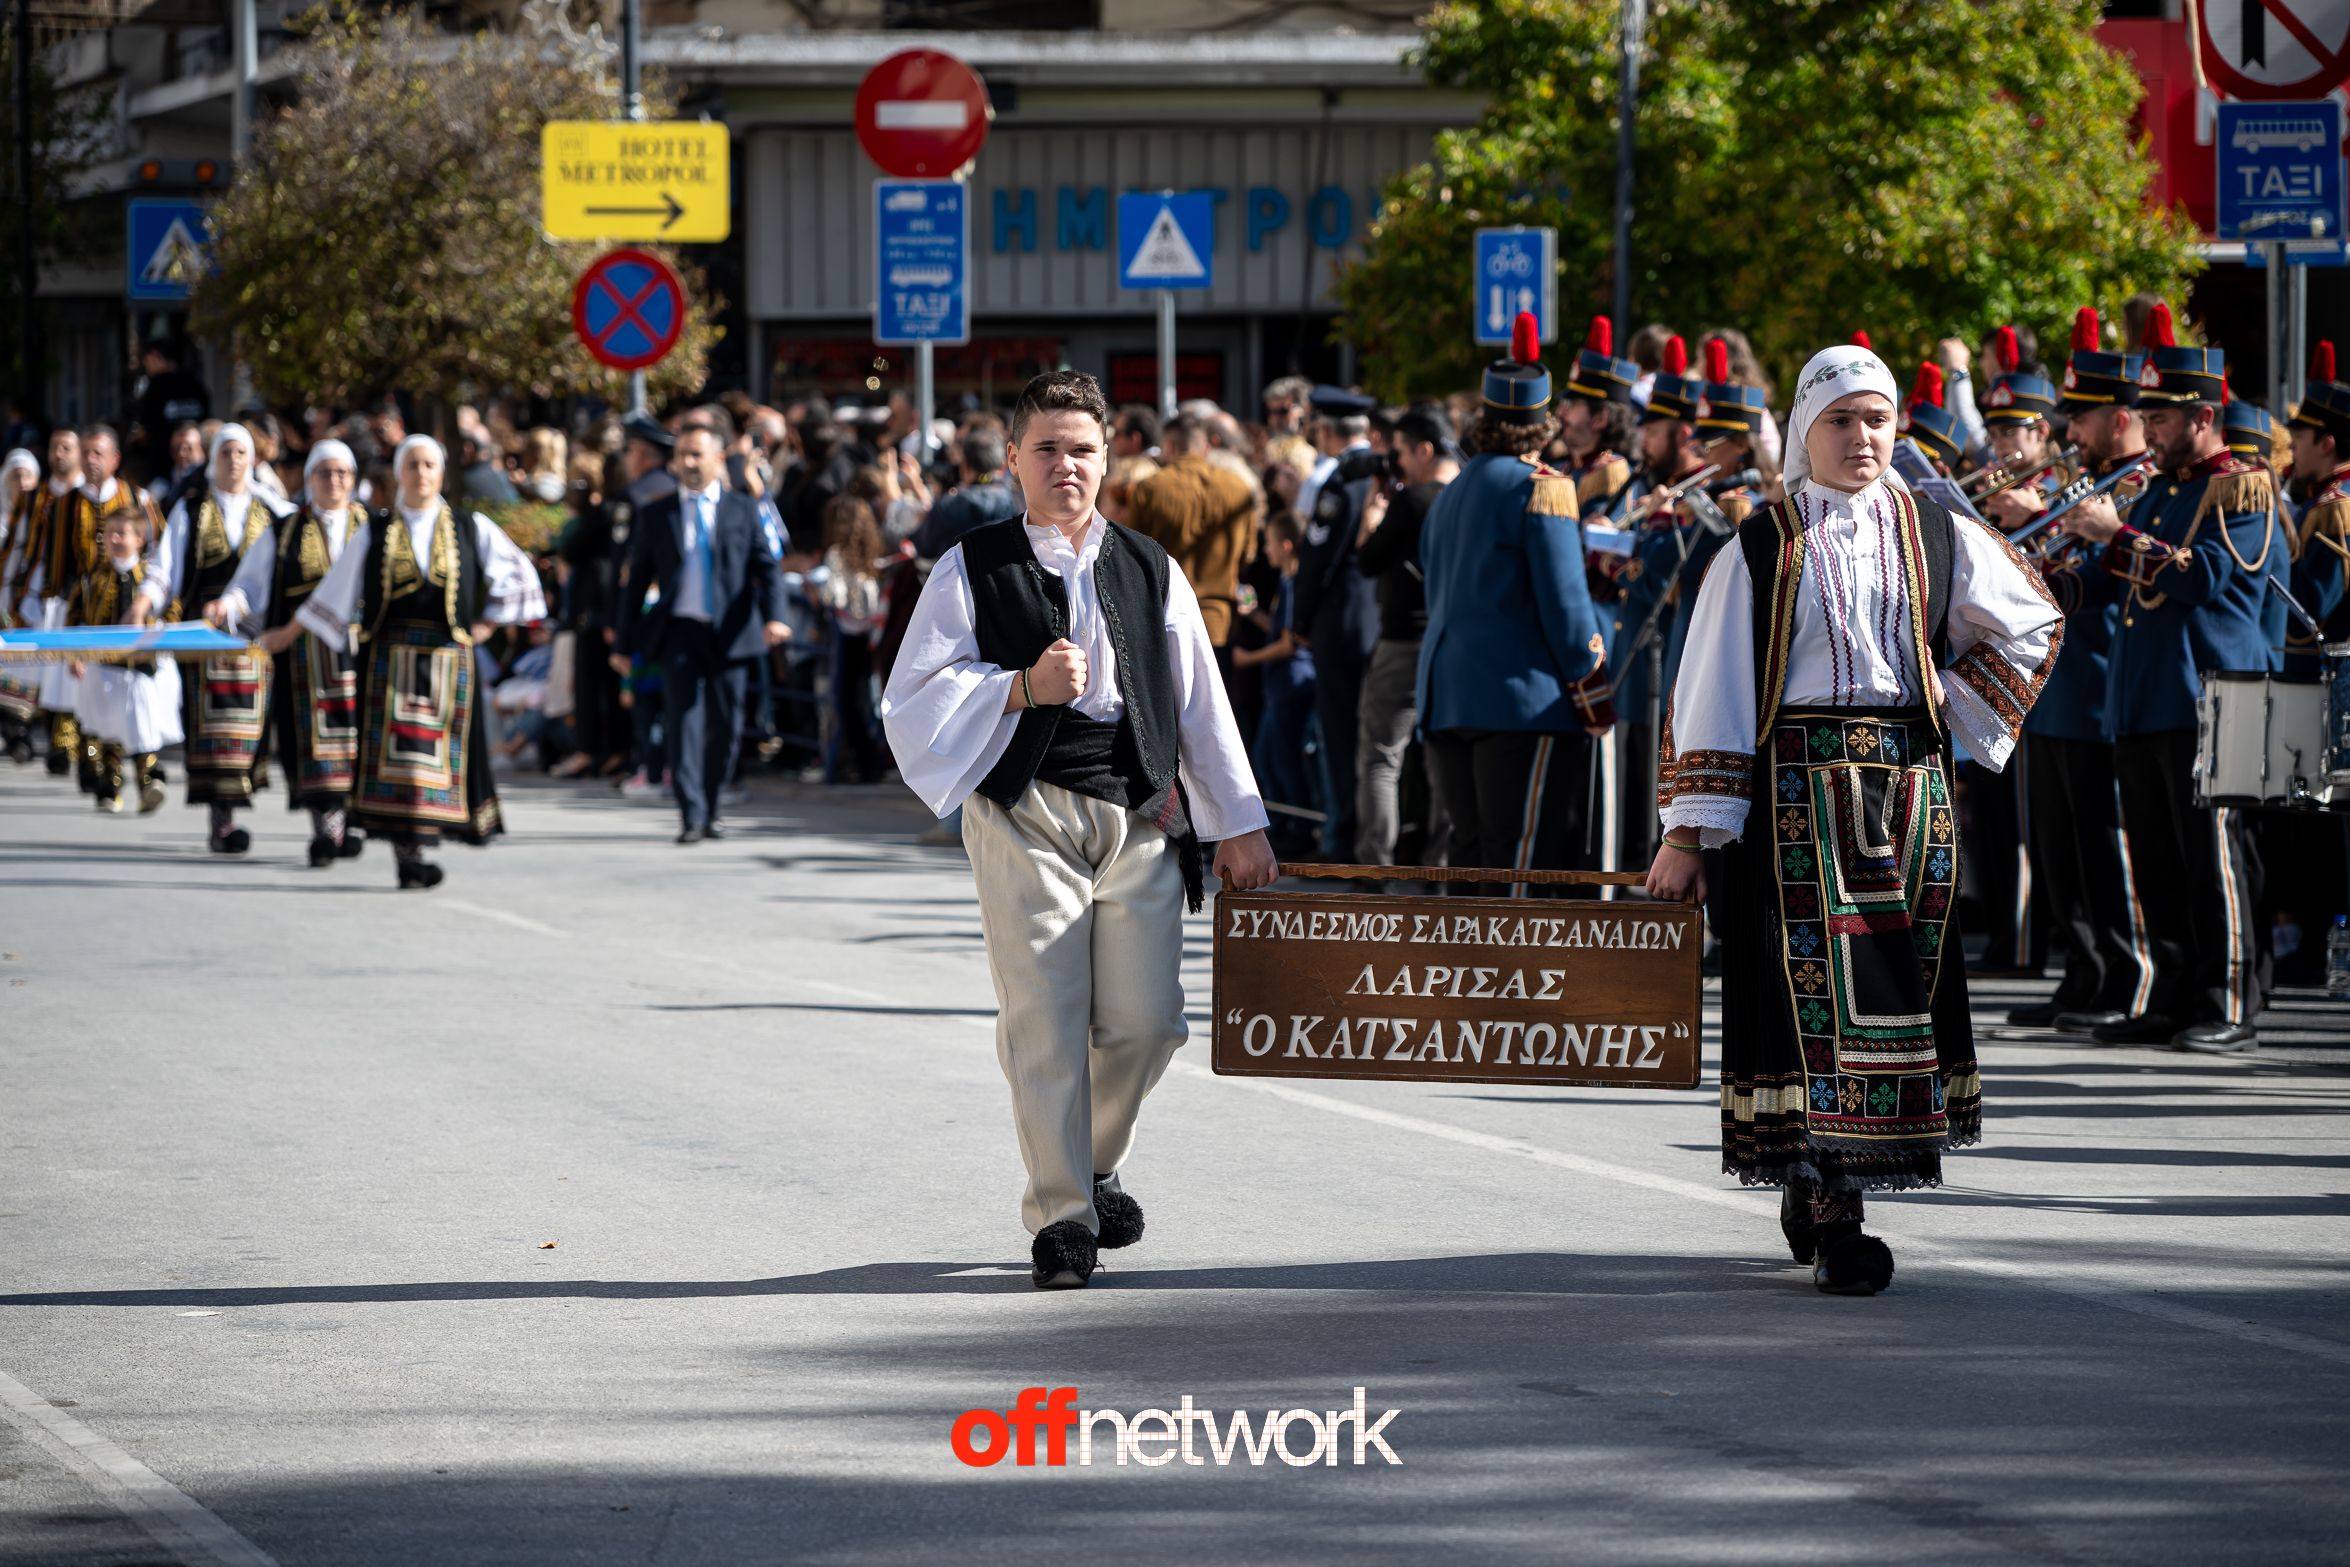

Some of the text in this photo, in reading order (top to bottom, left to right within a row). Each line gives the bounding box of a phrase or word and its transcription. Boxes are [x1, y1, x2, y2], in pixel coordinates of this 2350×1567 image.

[618, 137, 715, 159] HOTEL
[558, 162, 716, 184] METROPOL
[2237, 165, 2323, 197] ΤΑΞΙ
[1227, 908, 1687, 950] ΣΥΝΔΕΣΜΟΣ ΣΑΡΑΚΑΤΣΑΝΑΙΩΝ
[1345, 963, 1567, 1001] ΛΑΡΙΣΑΣ
